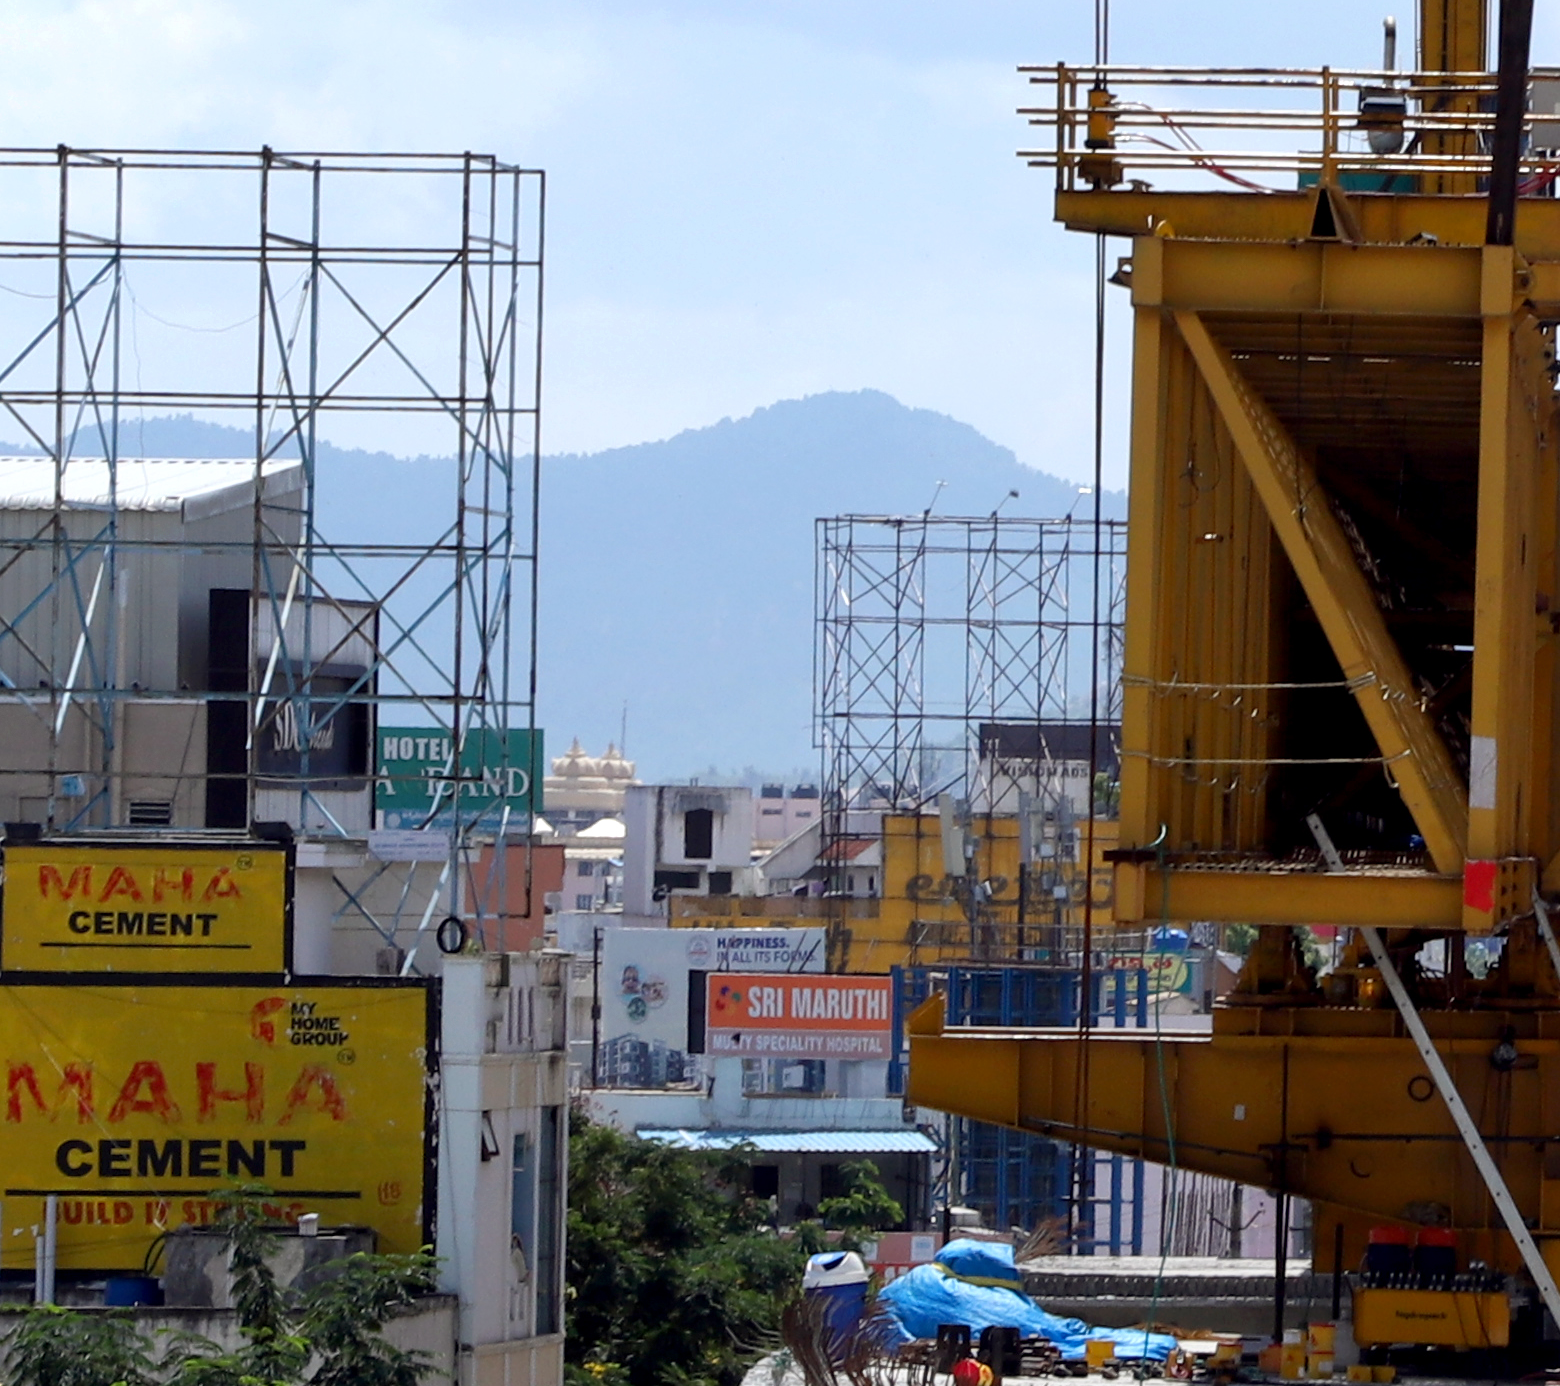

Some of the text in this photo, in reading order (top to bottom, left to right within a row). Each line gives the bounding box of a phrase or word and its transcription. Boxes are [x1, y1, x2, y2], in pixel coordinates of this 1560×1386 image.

[38, 866, 240, 904] MAHA
[68, 913, 218, 938] CEMENT
[717, 937, 790, 949] HAPPINESS.
[732, 951, 752, 963] ALL
[755, 951, 771, 963] ITS
[291, 1003, 317, 1015] MY
[748, 986, 888, 1020] SRI MARUTHI
[291, 1018, 340, 1030] HOME
[290, 1033, 349, 1045] GROUP
[756, 1035, 824, 1052] SPECIALITY
[827, 1037, 883, 1053] HOSPITAL
[6, 1061, 349, 1124] MAHA
[56, 1139, 306, 1177] CEMENT
